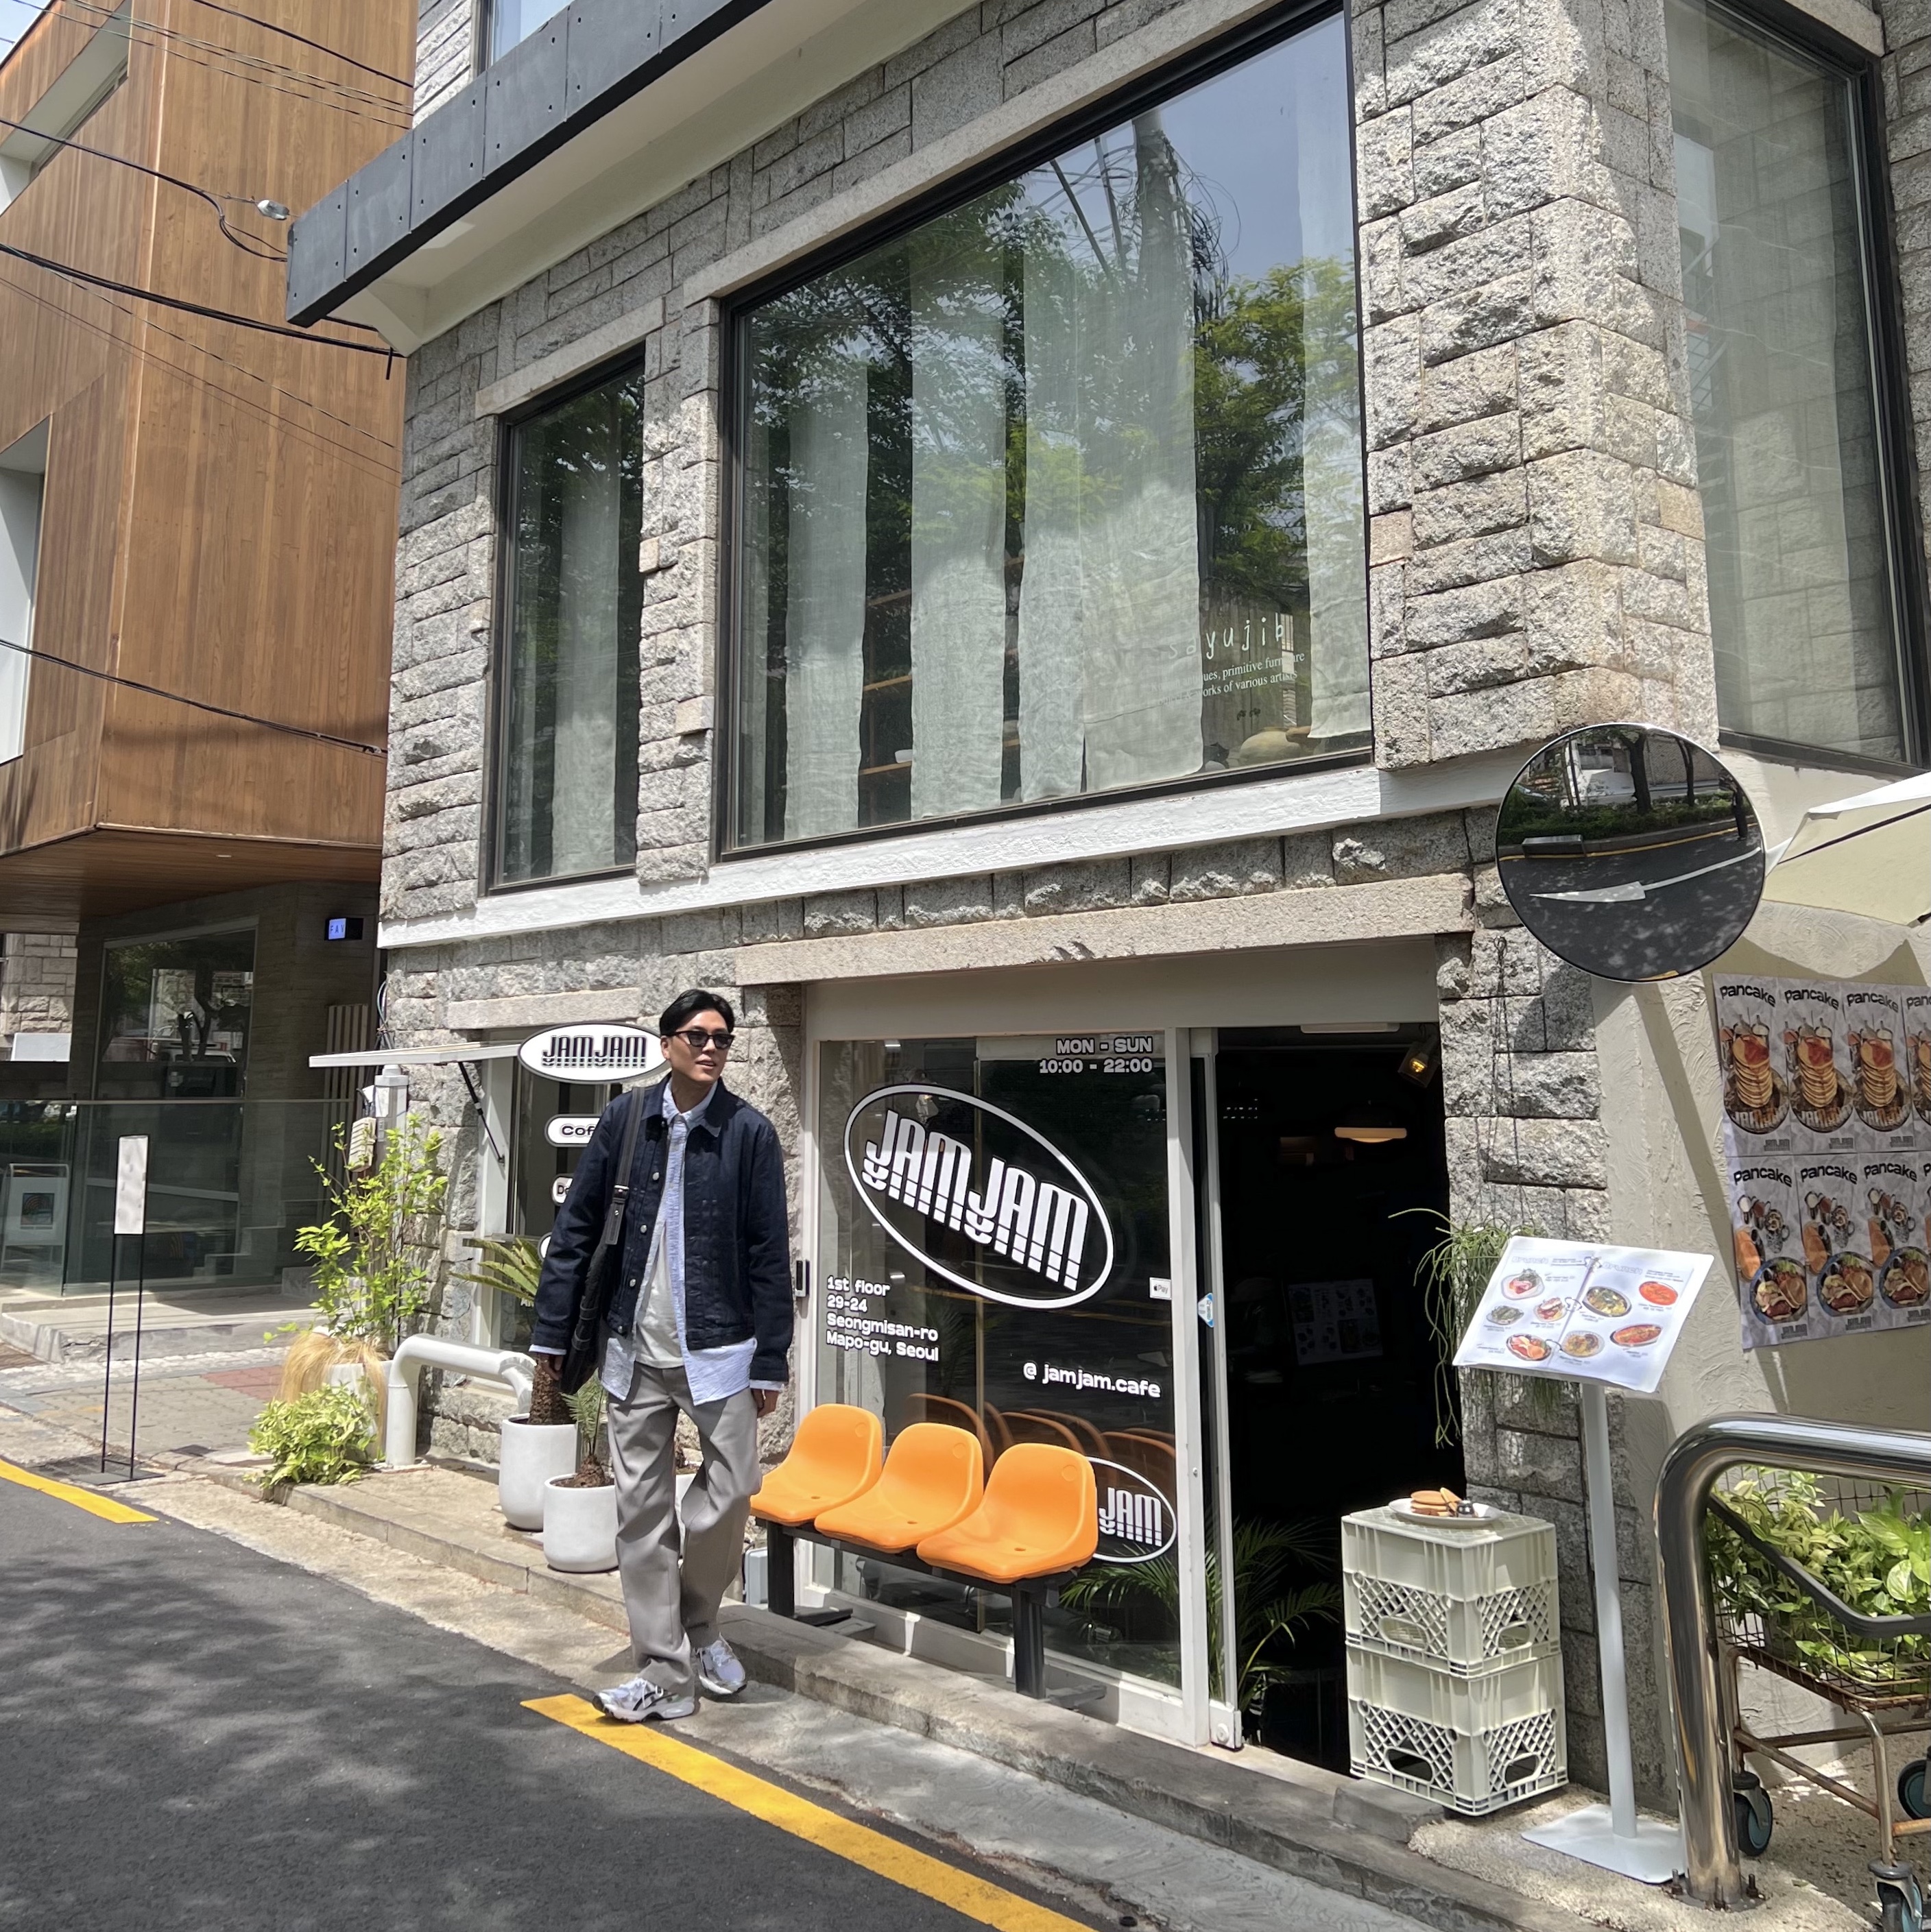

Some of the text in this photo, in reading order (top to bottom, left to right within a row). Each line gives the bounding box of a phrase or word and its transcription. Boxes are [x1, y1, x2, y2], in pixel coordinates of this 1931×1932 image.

[1223, 661, 1262, 681] primitive
[1265, 653, 1305, 669] furnre
[1223, 680, 1234, 692] of
[1235, 677, 1268, 690] various
[1720, 985, 1775, 1008] pancake
[1784, 989, 1838, 1011] pancake
[1847, 992, 1899, 1013] pancake
[1056, 1039, 1094, 1054] MON
[1114, 1037, 1153, 1052] SUN
[1040, 1059, 1083, 1074] 10:00
[1103, 1058, 1153, 1073] 22:00
[562, 1125, 595, 1136] Cof
[1734, 1167, 1792, 1187] pancake
[1801, 1165, 1858, 1185] pancake
[1864, 1163, 1917, 1183] pancake
[827, 1276, 891, 1296] 1st floor
[1158, 1284, 1168, 1294] Pay
[827, 1294, 867, 1312] 29-24
[827, 1313, 939, 1342] Seongmisan-ro
[826, 1331, 939, 1362] Mapo-gu, Seoul
[1023, 1362, 1161, 1398] @ jamjam.cafe
